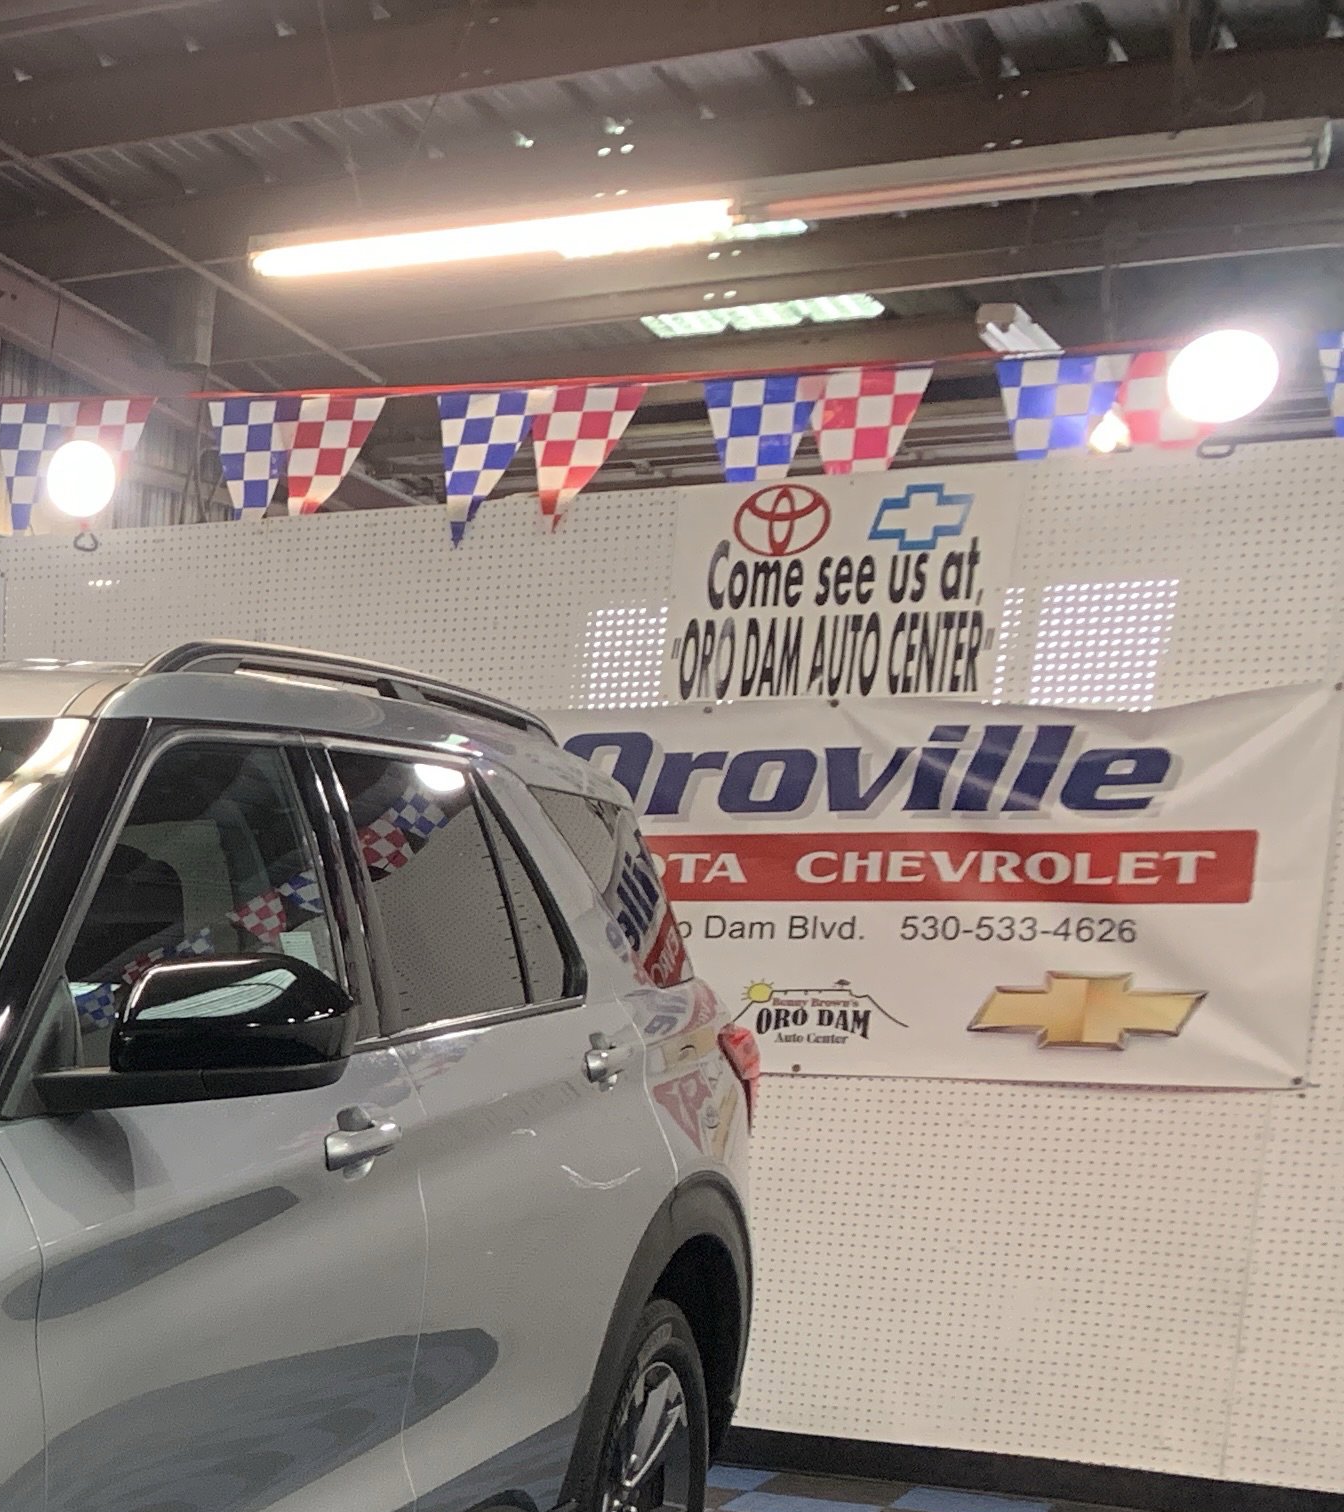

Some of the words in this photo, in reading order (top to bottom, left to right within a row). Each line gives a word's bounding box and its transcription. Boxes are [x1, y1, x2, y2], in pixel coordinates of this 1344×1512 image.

[707, 539, 804, 610] Come
[815, 554, 876, 606] see
[888, 552, 929, 604] us
[940, 537, 984, 606] at,
[671, 616, 735, 700] "ORO
[740, 616, 804, 697] DAM
[807, 611, 882, 697] AUTO
[888, 609, 995, 695] CENTER"
[796, 850, 1217, 886] CHEVROLET
[705, 916, 777, 940] Dam
[789, 916, 864, 940] Blvd.
[901, 916, 1138, 943] 530-533-4626
[756, 1007, 808, 1035] ORO
[816, 1008, 871, 1040] DAM
[774, 1032, 804, 1043] Auto
[806, 1032, 849, 1044] Center
